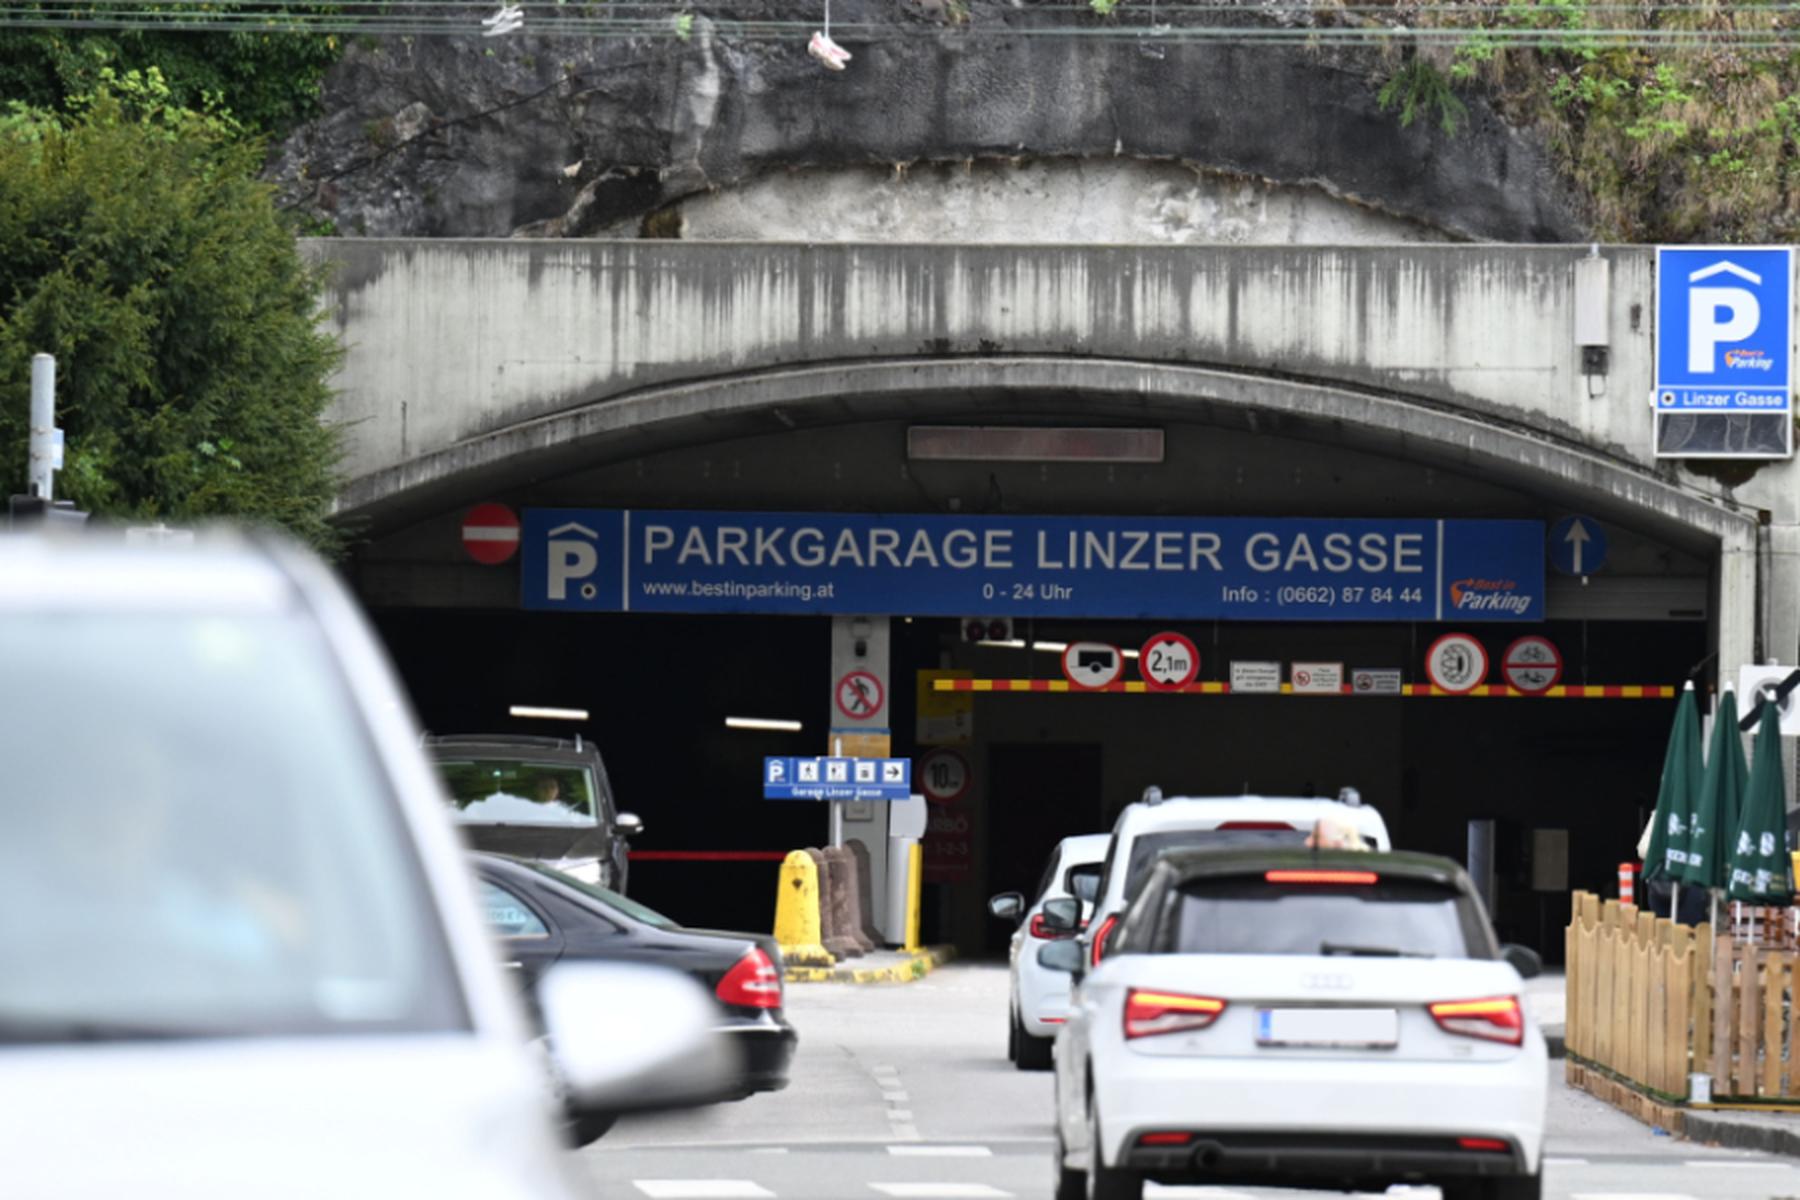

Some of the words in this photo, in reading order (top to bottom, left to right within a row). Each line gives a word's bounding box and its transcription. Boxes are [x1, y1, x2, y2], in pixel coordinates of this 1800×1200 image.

[1683, 393, 1730, 406] Linzer
[1735, 392, 1783, 406] Gasse
[644, 525, 1013, 569] PARKGARAGE
[1037, 530, 1223, 571] LINZER
[1245, 532, 1424, 573] GASSE
[643, 581, 834, 601] www.bestinparking.at
[982, 583, 994, 600] 0
[1012, 583, 1035, 600] 24
[1040, 584, 1073, 600] Uhr
[1222, 585, 1259, 603] Info
[1277, 586, 1336, 606] (0662)
[1342, 586, 1365, 603] 87
[1370, 587, 1393, 603] 84
[1399, 587, 1422, 603] 44
[1458, 590, 1532, 615] Parking
[1151, 650, 1188, 673] 2,1m
[931, 763, 949, 789] 10
[826, 787, 854, 797] Linzer
